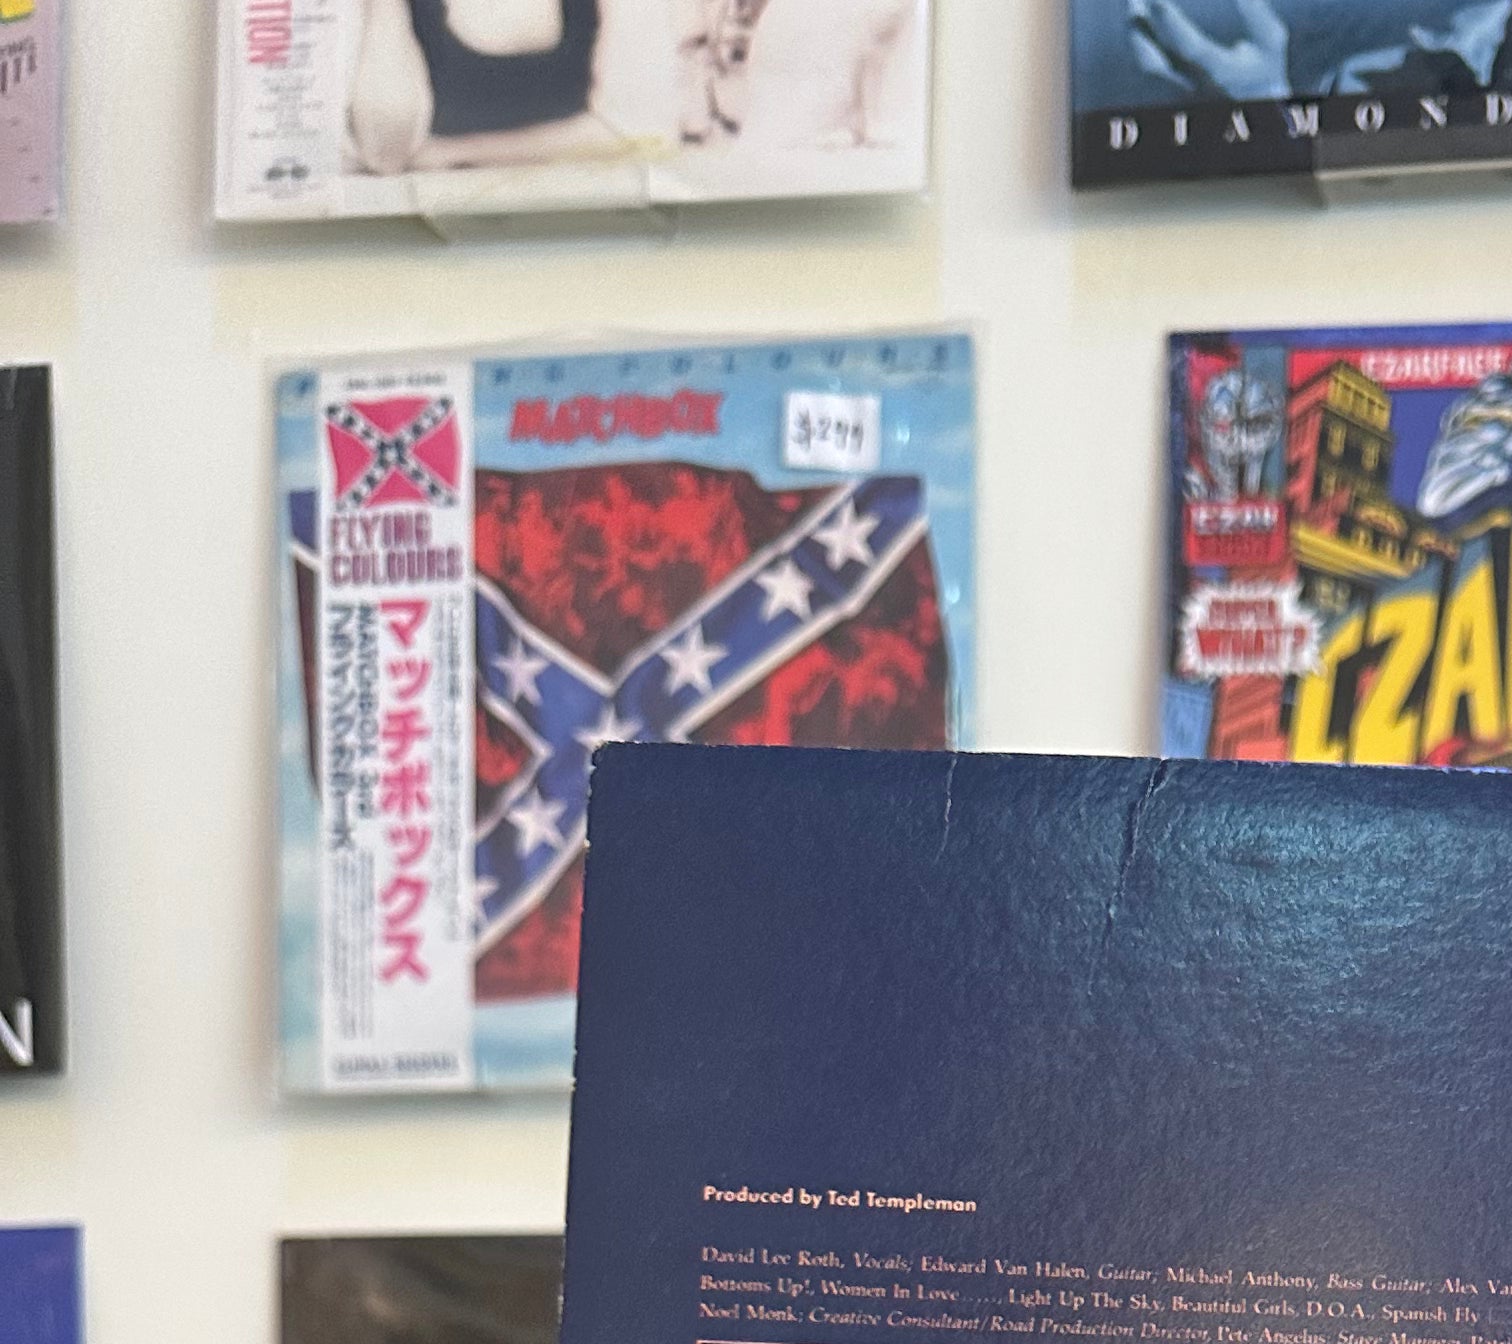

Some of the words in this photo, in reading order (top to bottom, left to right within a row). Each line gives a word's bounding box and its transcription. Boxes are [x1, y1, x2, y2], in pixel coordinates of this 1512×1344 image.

[330, 512, 431, 550] FLYING
[330, 548, 462, 587] COLOURS
[702, 1185, 794, 1205] Produced
[798, 1189, 823, 1210] by
[827, 1190, 861, 1208] Ted
[866, 1192, 977, 1216] Templeman
[700, 1246, 756, 1265] David
[760, 1249, 792, 1266] Lee
[796, 1250, 846, 1271] Roth,
[920, 1254, 987, 1273] Edward
[993, 1257, 1028, 1274] Van
[1166, 1265, 1234, 1285] Michael
[1241, 1269, 1319, 1291] Anthony,
[1326, 1272, 1364, 1290] Bass
[1439, 1276, 1479, 1294] Alex
[699, 1274, 772, 1293] Bottoms
[820, 1278, 887, 1297] Women
[892, 1281, 911, 1298] In
[1008, 1286, 1052, 1308] Light
[1058, 1288, 1086, 1310] Up
[1090, 1290, 1124, 1308] The
[1129, 1292, 1166, 1314] Sky,
[1171, 1294, 1247, 1314] Beautiful
[1381, 1303, 1448, 1325] Spanish
[698, 1302, 741, 1320] Noel
[807, 1306, 882, 1325] Creative
[1039, 1316, 1135, 1337] Production
[1217, 1325, 1253, 1343] Pete
